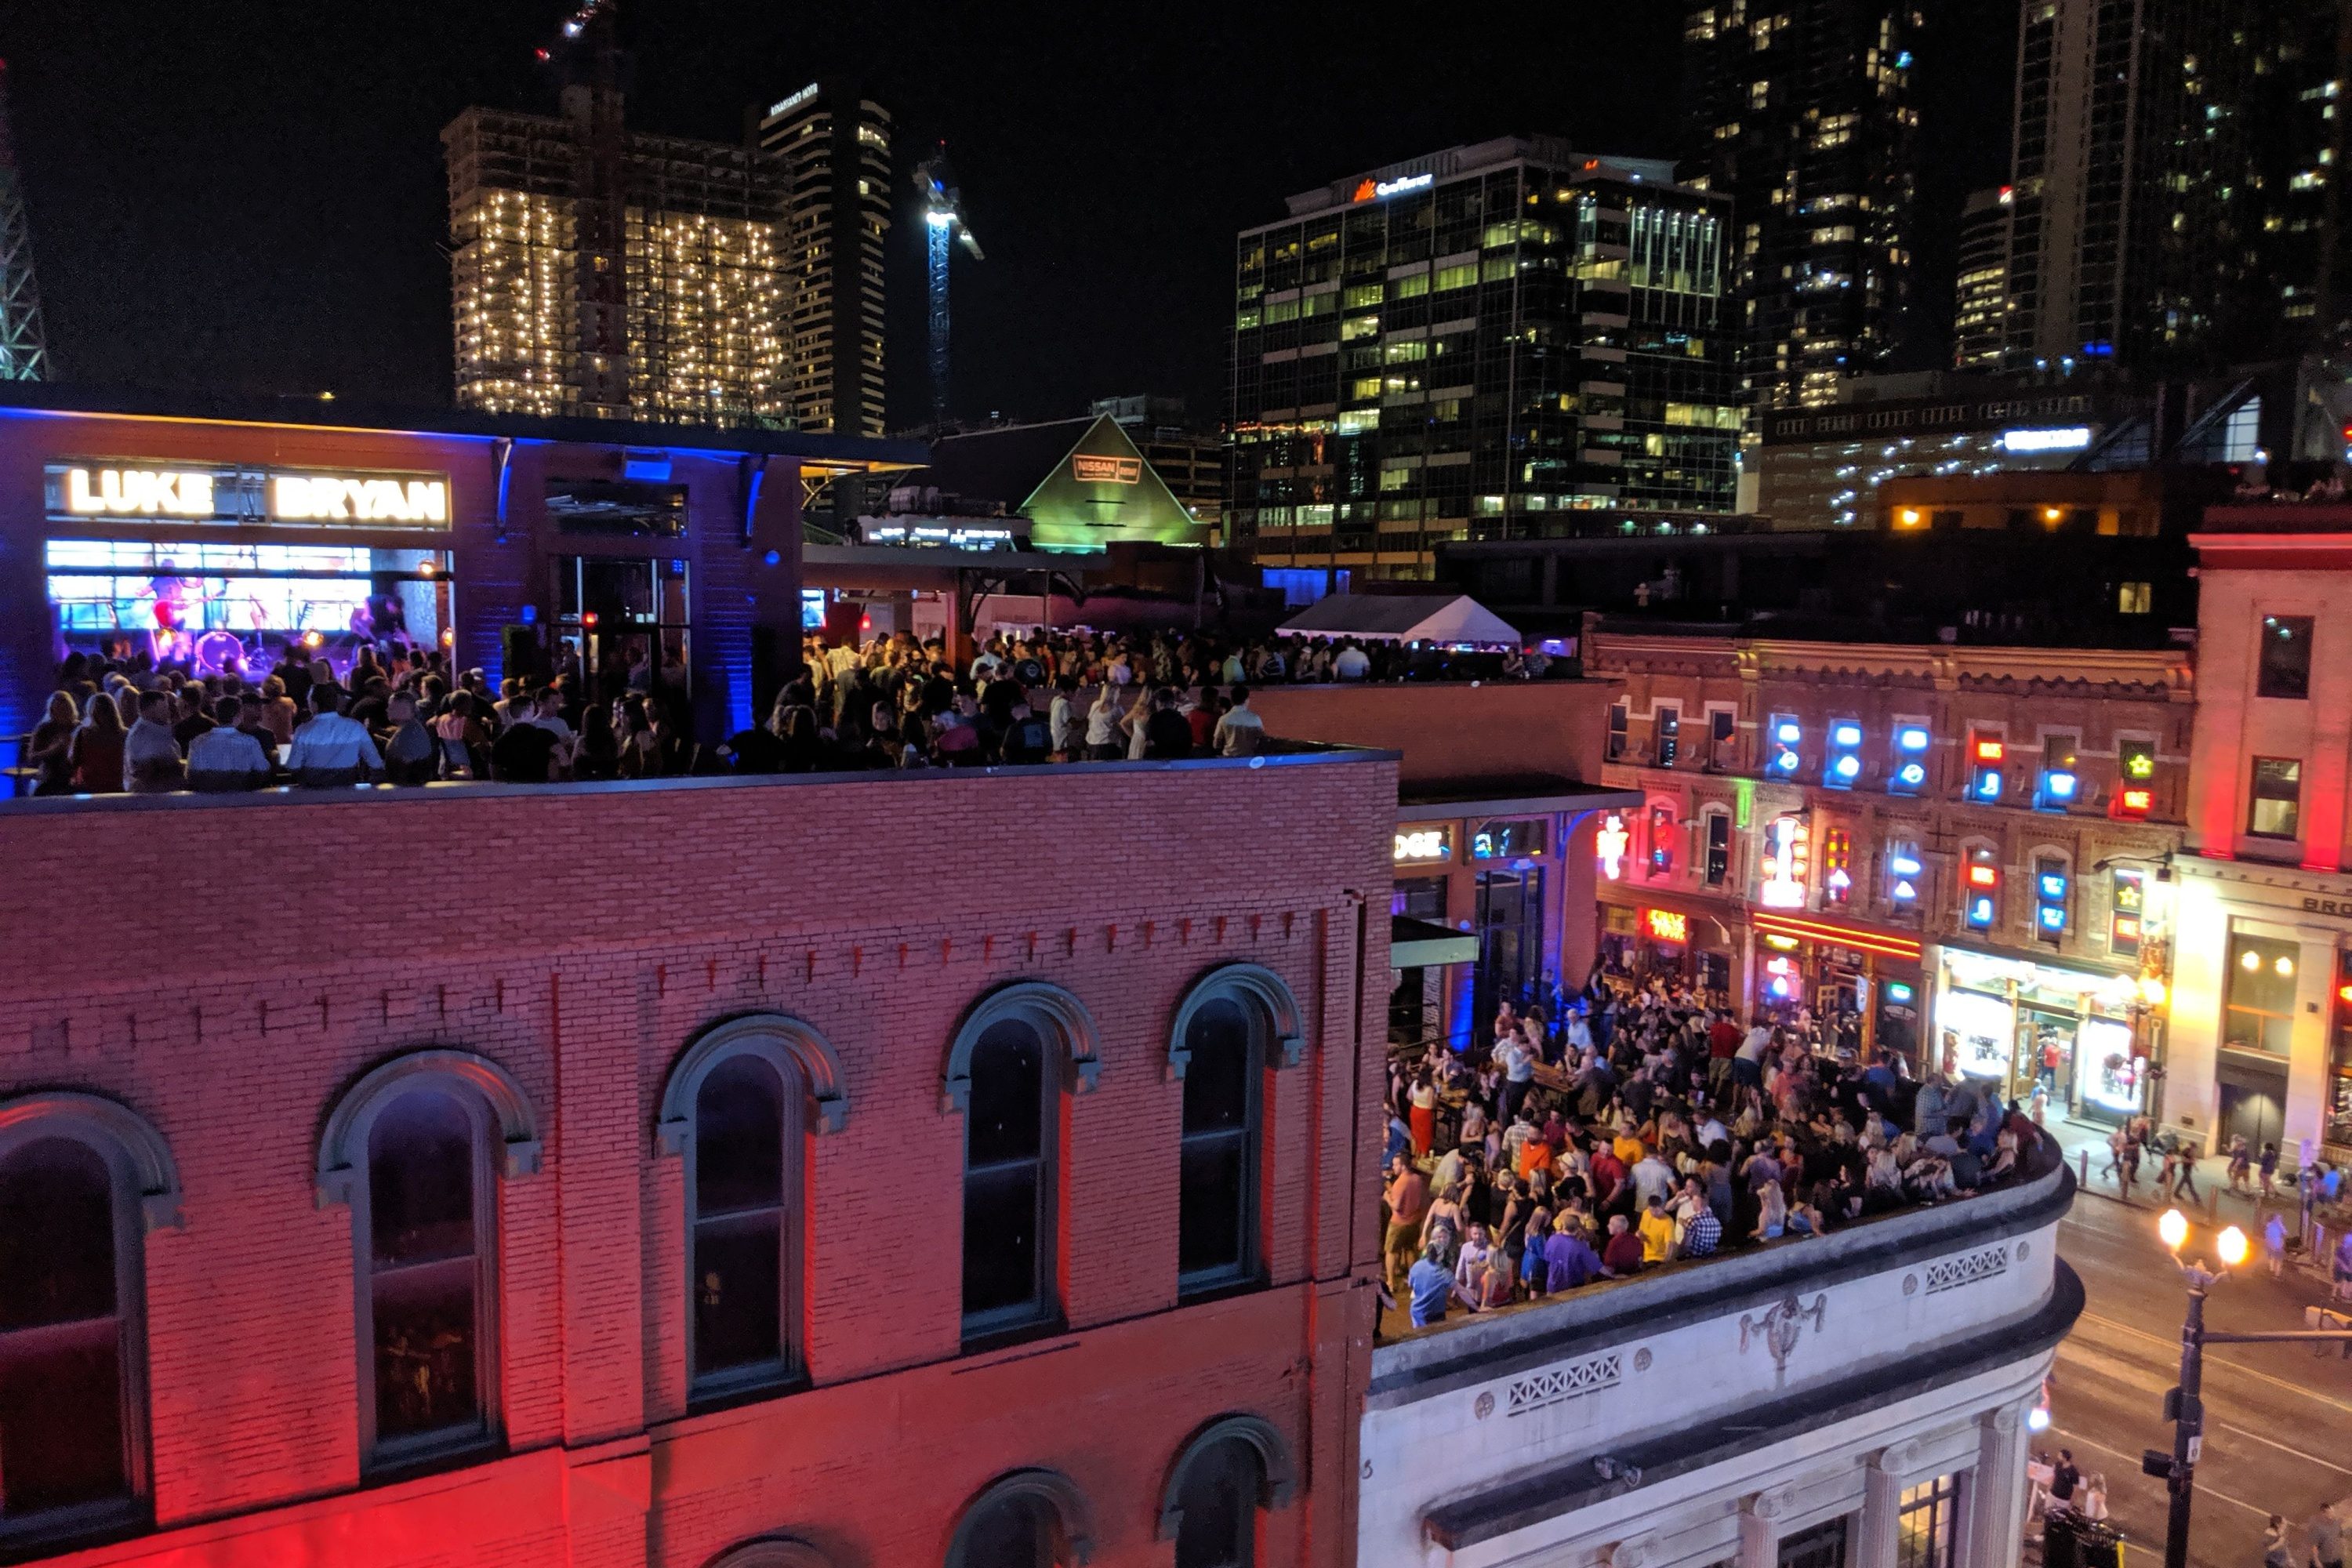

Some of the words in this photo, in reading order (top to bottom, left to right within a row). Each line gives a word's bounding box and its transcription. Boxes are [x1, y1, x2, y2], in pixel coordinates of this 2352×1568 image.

[1077, 459, 1116, 472] NISSAN
[72, 469, 212, 514] LUKE
[276, 477, 445, 520] BRYAN
